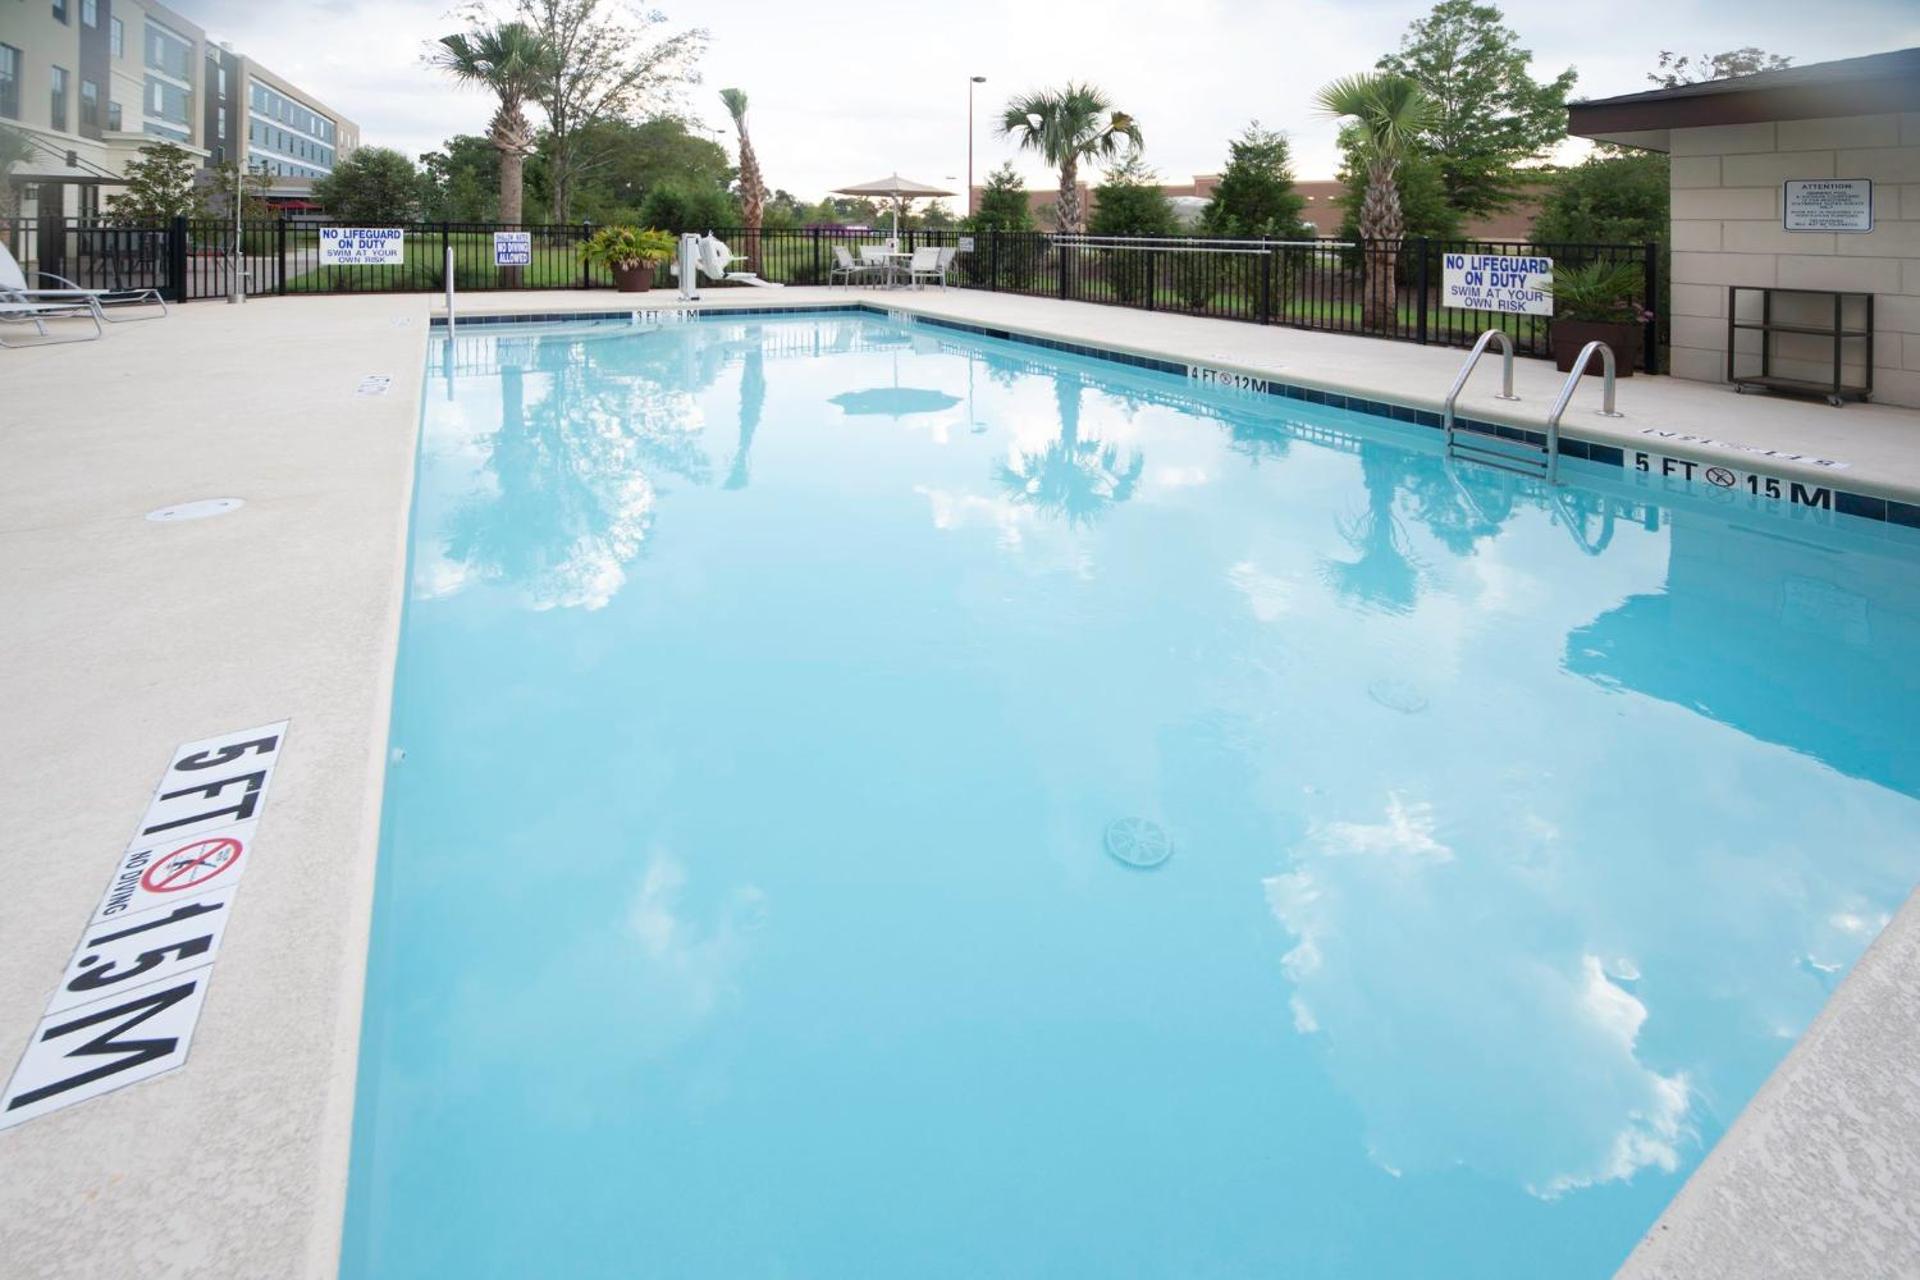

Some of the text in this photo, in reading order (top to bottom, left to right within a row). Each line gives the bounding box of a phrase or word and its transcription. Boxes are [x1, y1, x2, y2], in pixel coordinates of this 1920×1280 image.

[323, 229, 401, 239] NO LIFEGUARD
[338, 239, 386, 249] ON DUTY
[327, 249, 352, 257] SWIM
[372, 249, 398, 257] YOUR
[1446, 255, 1549, 274] NO LIFEGUARD
[1465, 271, 1527, 288] ON DUTY
[1451, 285, 1544, 302] SWIM AT YOUR
[1464, 297, 1527, 312] OWN RISK
[1202, 368, 1217, 384] FT
[1635, 452, 1699, 481] 5 FT
[102, 850, 153, 915] NO DIVING
